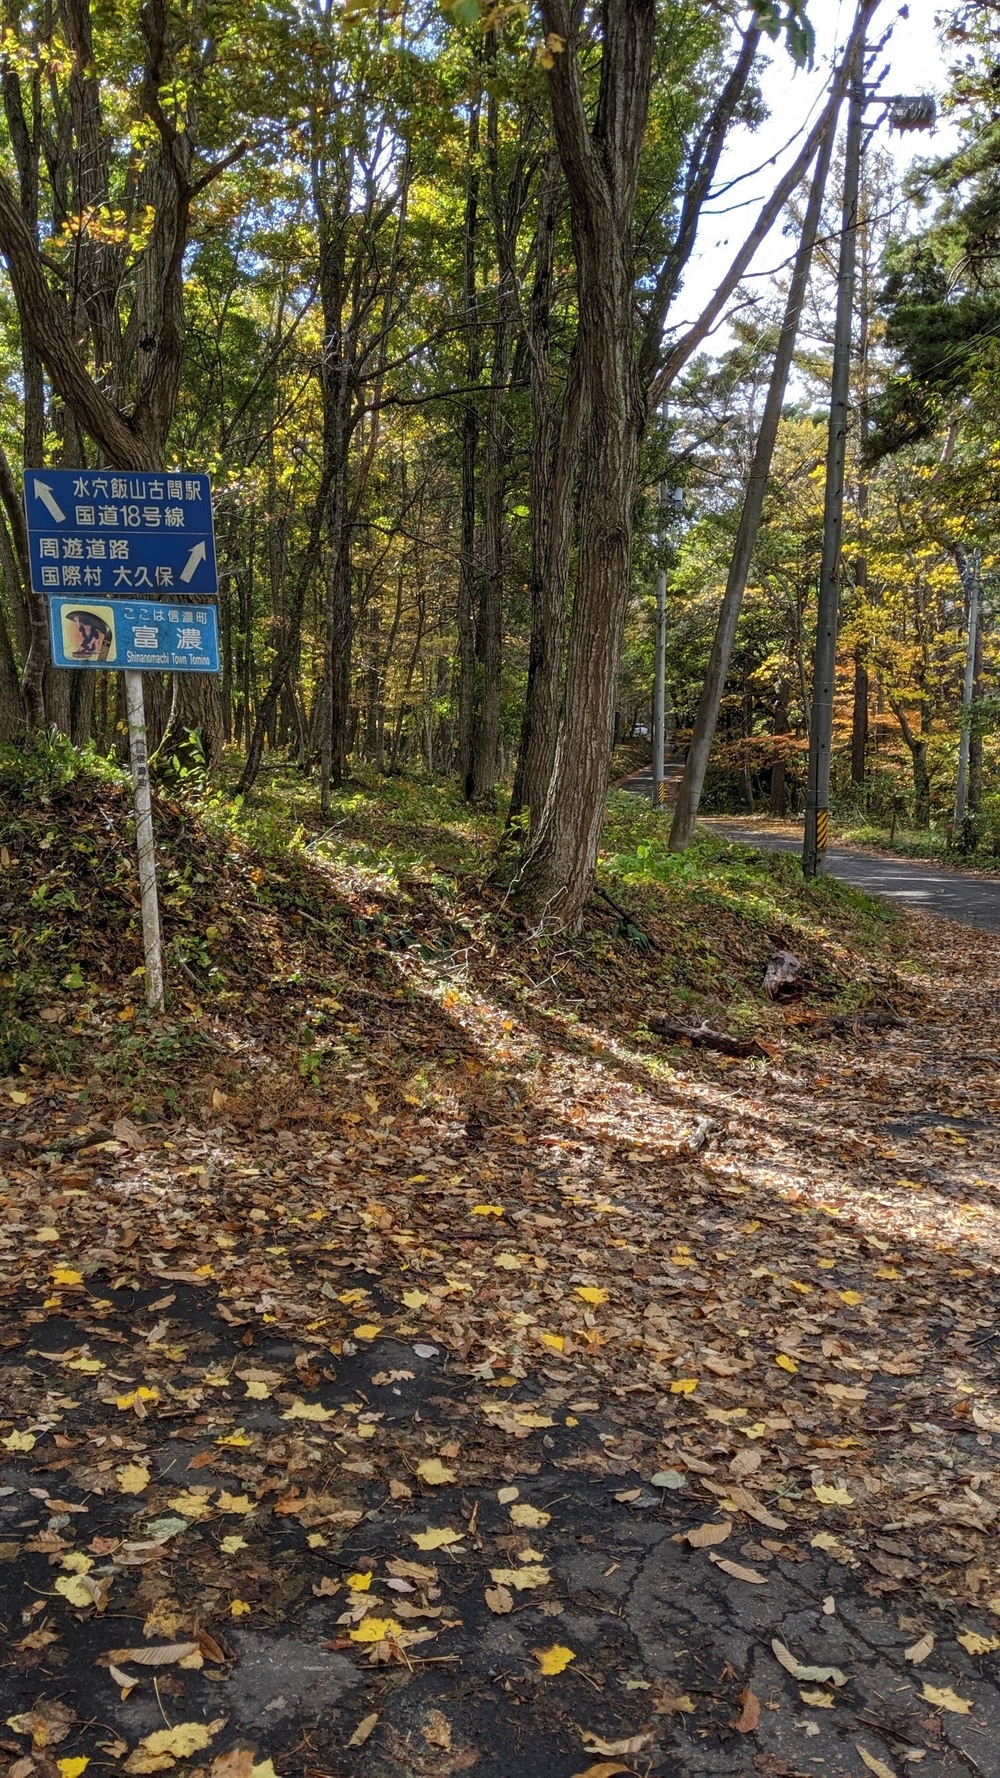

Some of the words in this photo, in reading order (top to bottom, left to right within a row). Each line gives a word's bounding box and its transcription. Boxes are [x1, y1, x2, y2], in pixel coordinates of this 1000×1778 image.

[72, 477, 202, 501] 水穴飯山古間駅
[75, 505, 185, 527] 国道18号線
[39, 538, 130, 559] 周遊道路
[41, 565, 102, 587] 国際村
[113, 565, 174, 587] 大久保
[124, 607, 207, 625] ここは信濃町
[132, 625, 203, 650] 富濃
[126, 650, 169, 663] Shinanomachi
[171, 653, 187, 664] Town
[189, 653, 210, 665] Tomino
